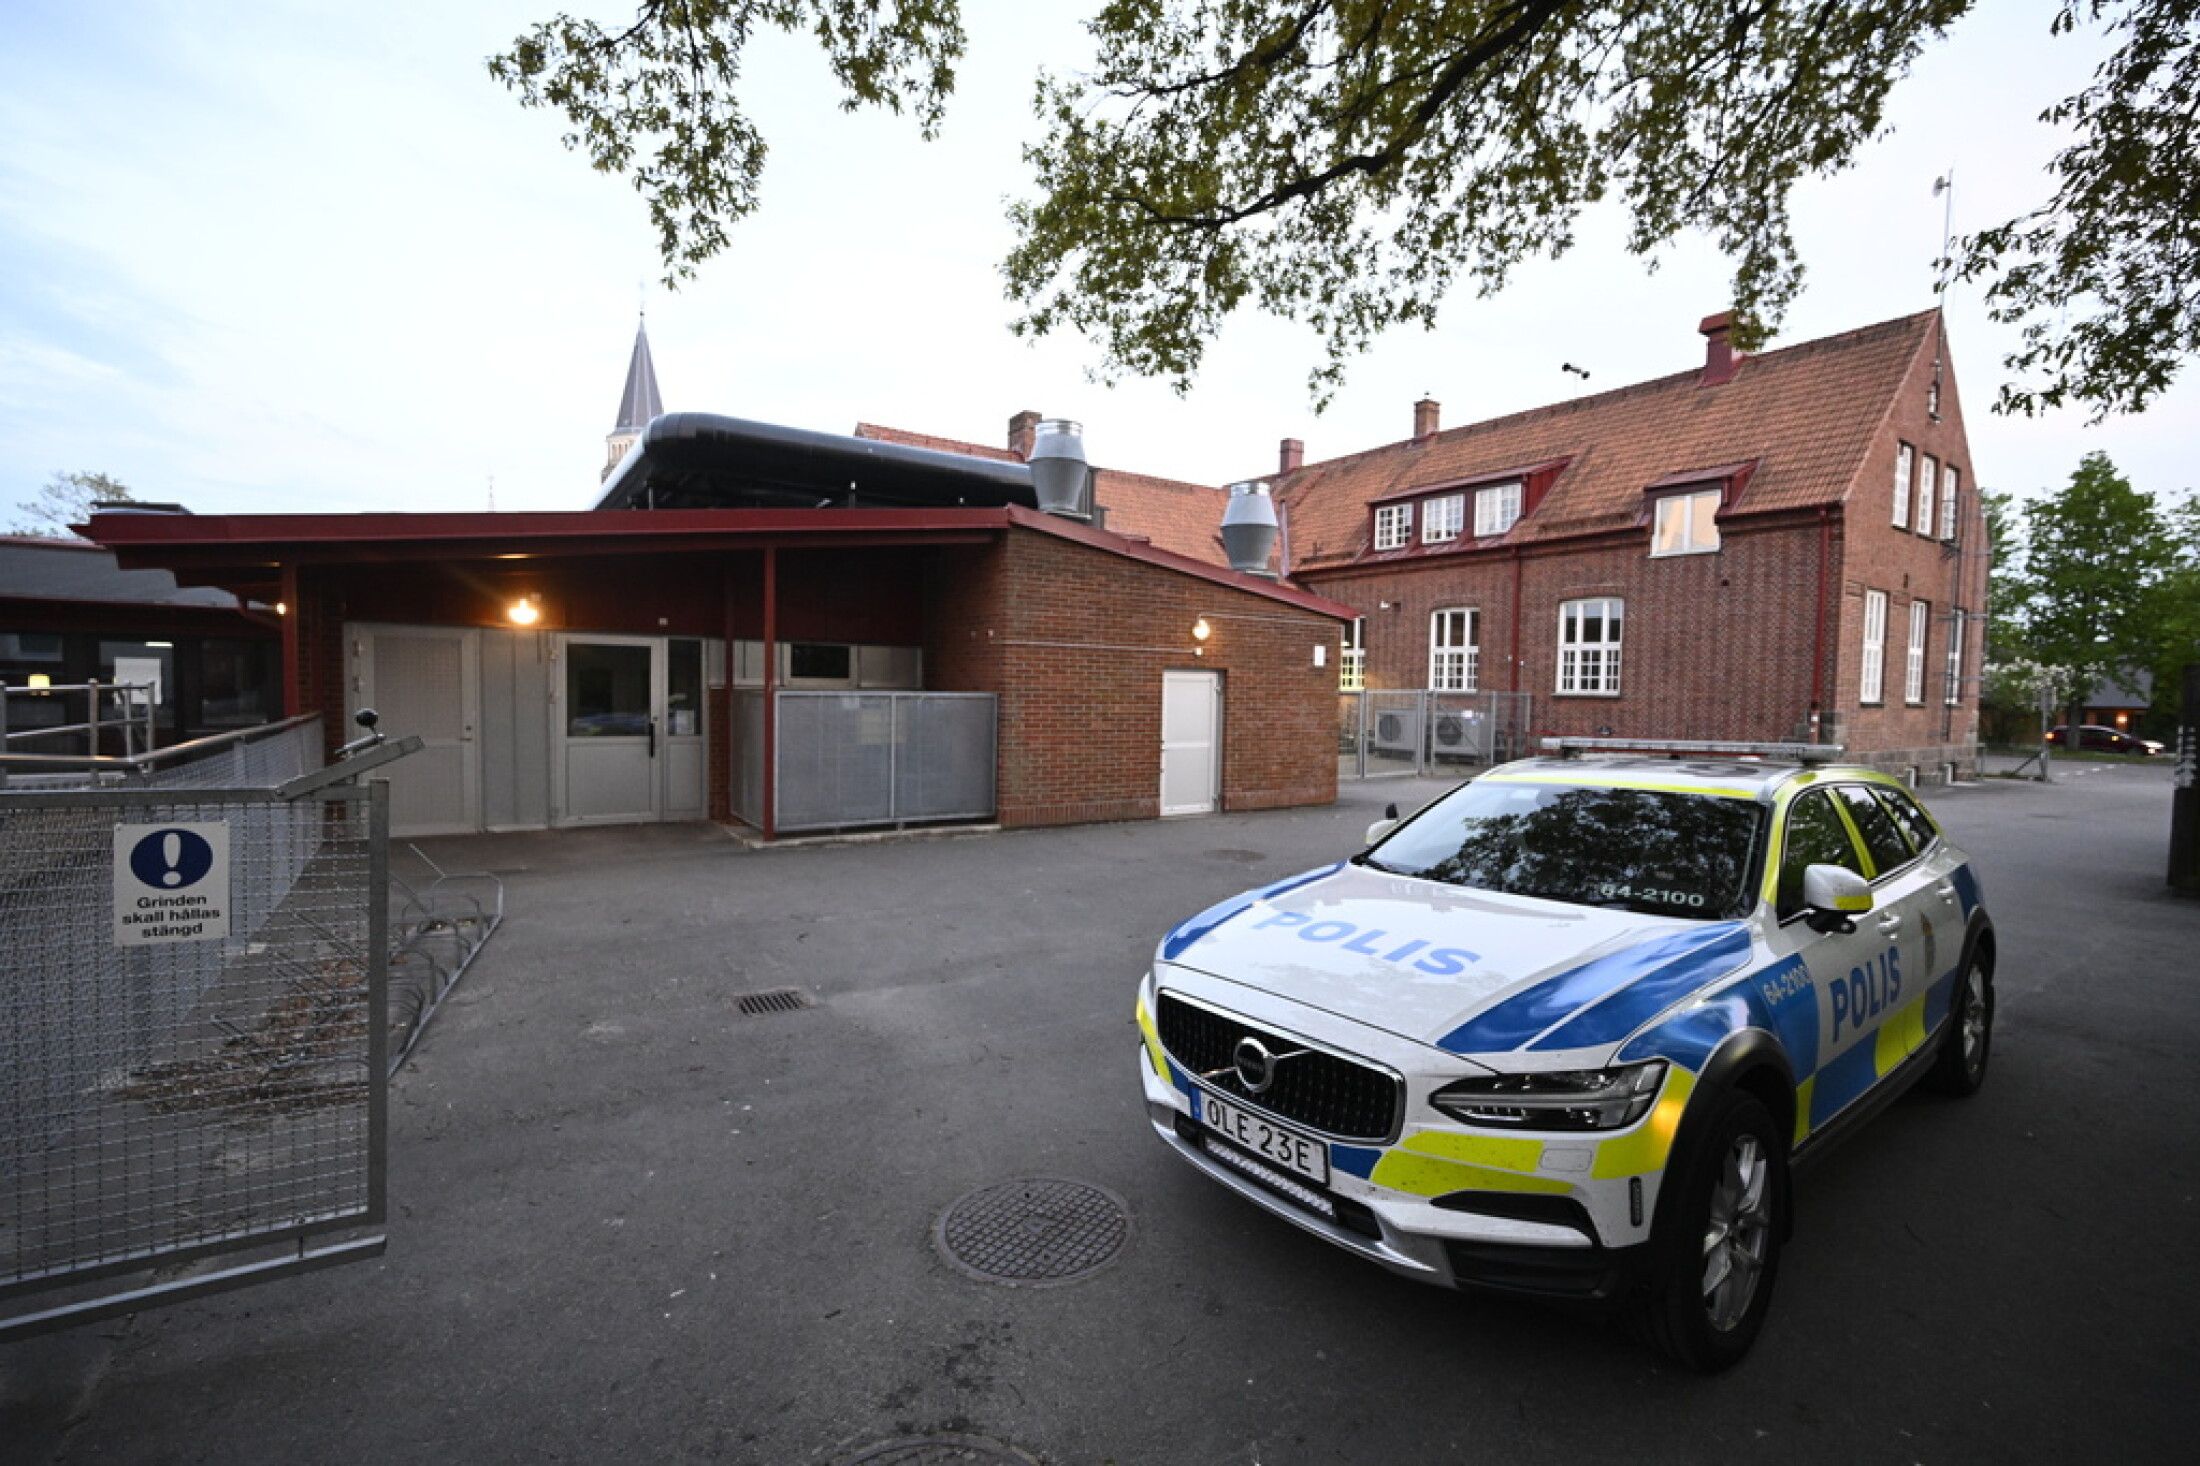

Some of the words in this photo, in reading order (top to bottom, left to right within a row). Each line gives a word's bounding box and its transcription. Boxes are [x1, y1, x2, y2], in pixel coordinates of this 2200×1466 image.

[136, 895, 207, 908] Grinden
[1600, 881, 1704, 907] 64-2100
[122, 911, 164, 925] skall
[169, 909, 220, 921] hållas
[142, 923, 203, 938] stängd
[1254, 911, 1482, 975] POLIS
[1830, 945, 1900, 1044] POLIS
[1207, 1099, 1249, 1144] OLE
[1258, 1123, 1312, 1172] 23E
